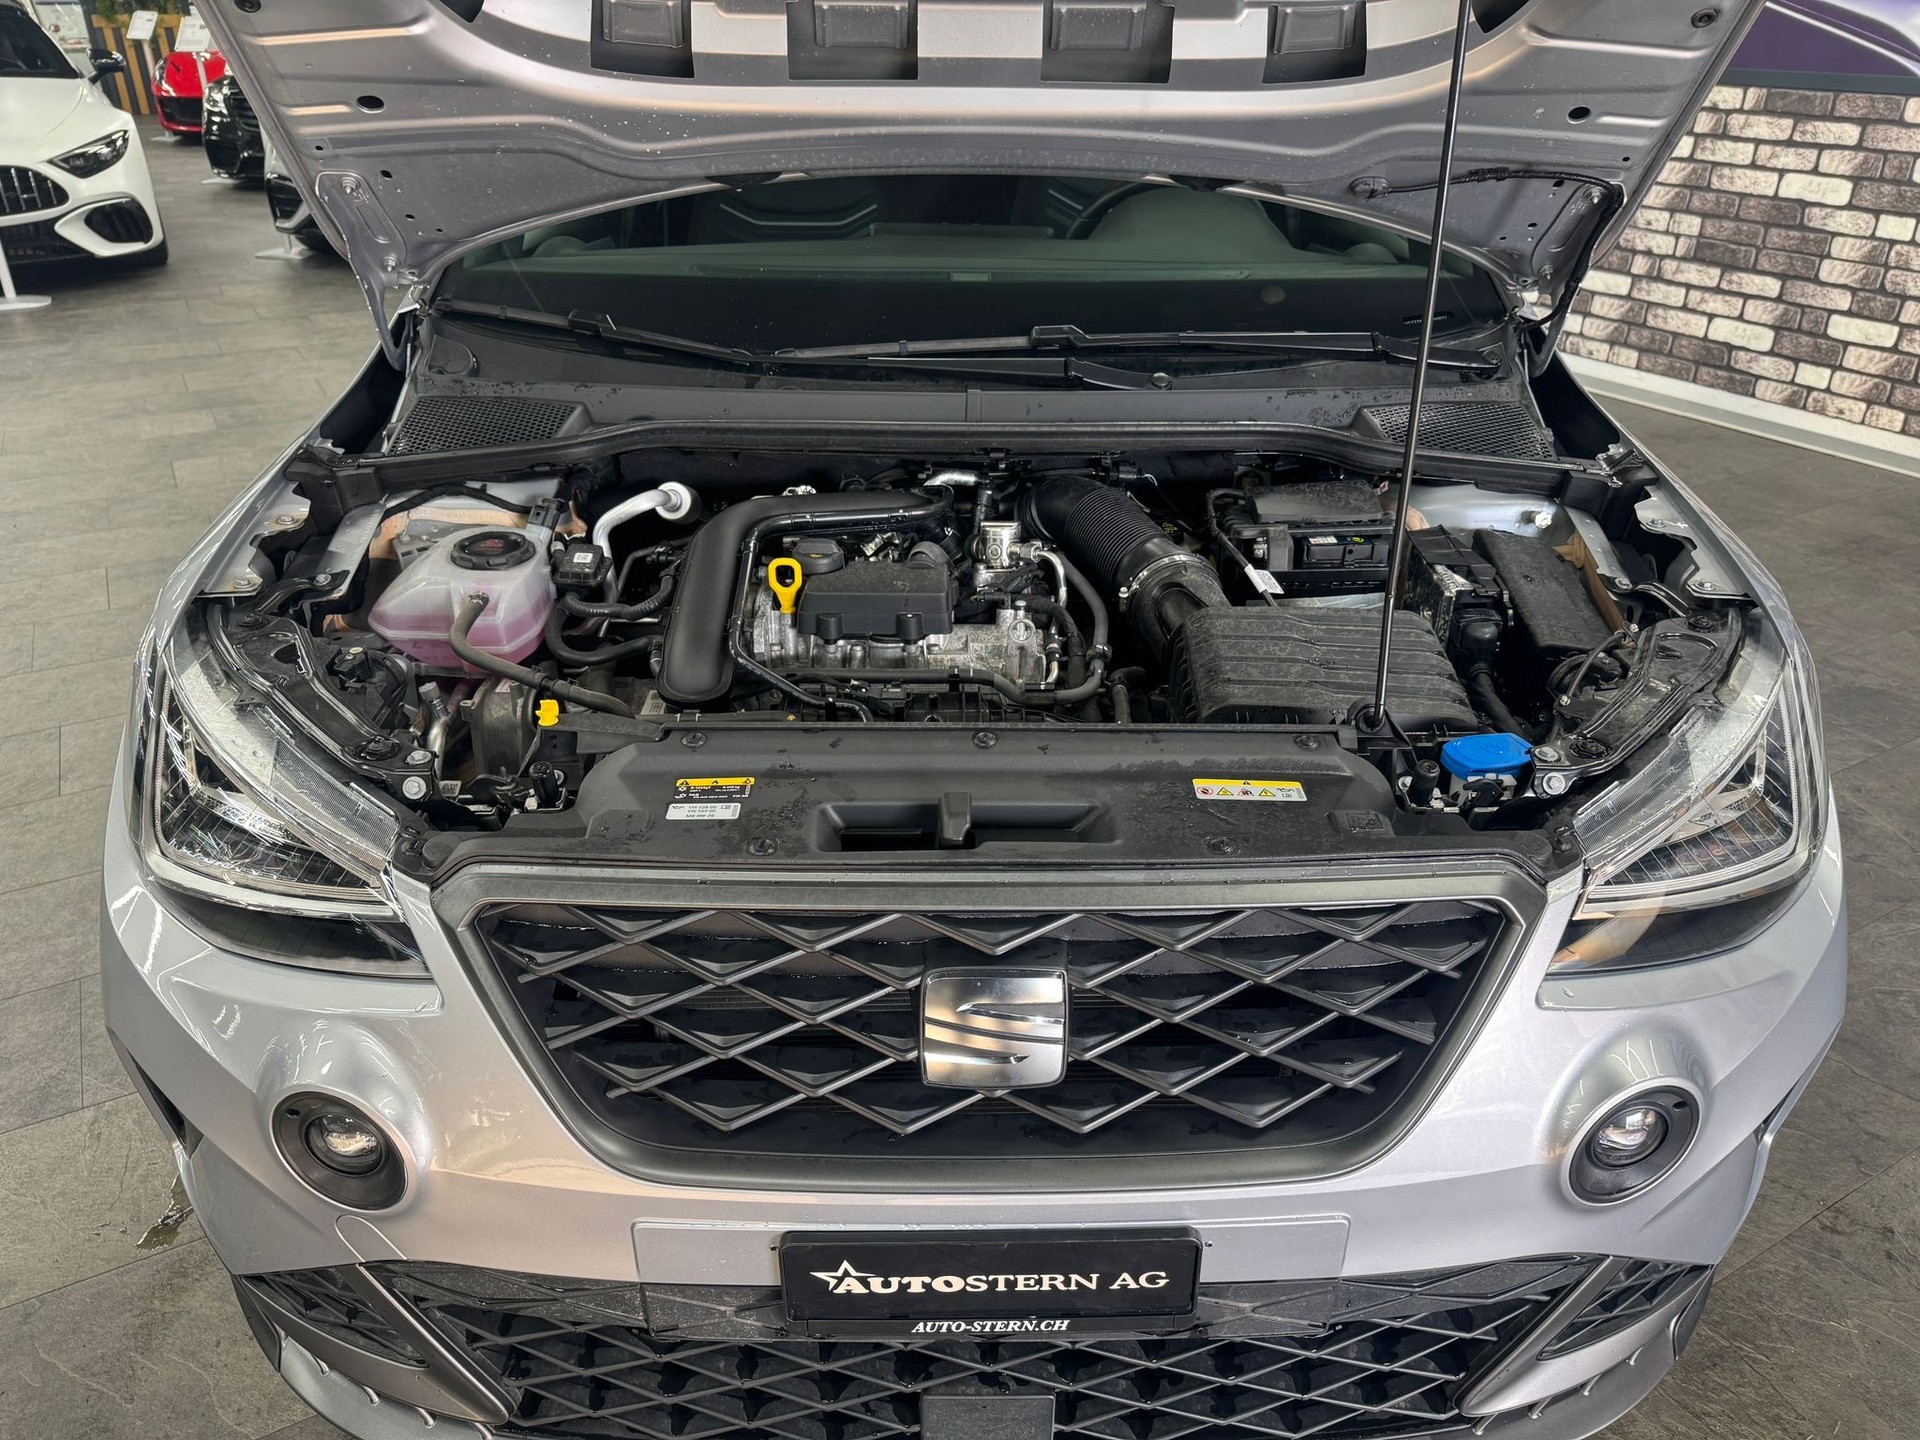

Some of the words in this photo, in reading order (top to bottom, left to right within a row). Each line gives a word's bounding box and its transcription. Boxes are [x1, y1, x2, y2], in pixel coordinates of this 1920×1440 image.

[832, 1273, 1098, 1294] AUTOSTERN
[1109, 1271, 1170, 1289] AG
[911, 1319, 1070, 1333] AUTO-STERN.CH
